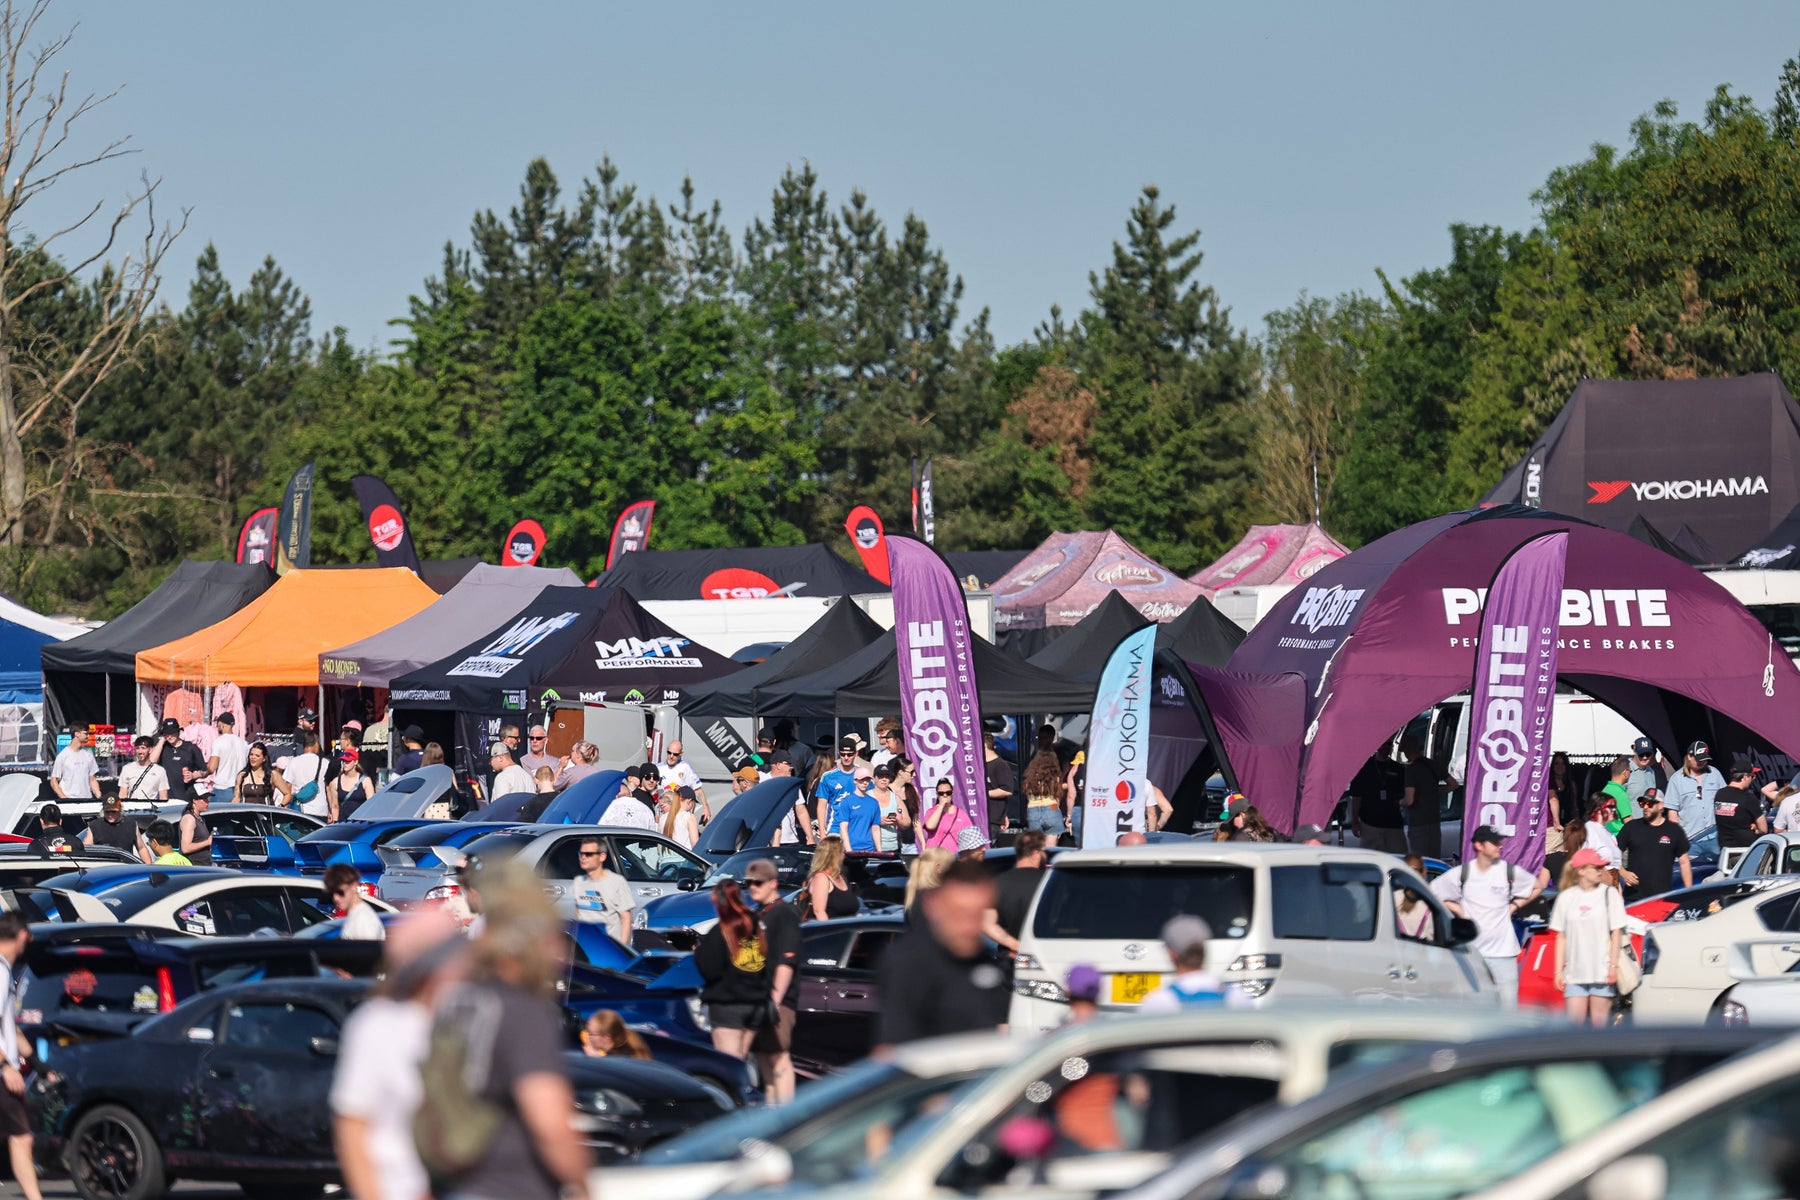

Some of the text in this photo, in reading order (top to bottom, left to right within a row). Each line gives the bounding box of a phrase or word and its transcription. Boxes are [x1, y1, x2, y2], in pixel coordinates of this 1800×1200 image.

[1631, 475, 1769, 502] YOKOHAMA
[373, 518, 400, 537] TGR
[856, 528, 876, 537] TGR
[512, 542, 533, 552] TGR
[711, 587, 768, 599] TGR
[1290, 584, 1365, 634] PROBITE
[1442, 588, 1671, 627] PBITE
[480, 612, 581, 656] MMT
[1278, 637, 1319, 650] PERFORMANCE
[1603, 639, 1675, 650] BRAKES
[595, 636, 690, 659] MMT
[324, 659, 358, 675] NO MONEY
[602, 658, 695, 668] PERFORMANCE
[579, 690, 607, 702] MMT
[954, 618, 978, 817] PERFORMANCE BRAKES
[1118, 644, 1145, 776] YOKOHAMA
[705, 720, 738, 753] MMT
[1478, 624, 1529, 837] PROBITE
[1529, 627, 1552, 837] PERFORMANCE BRAKES
